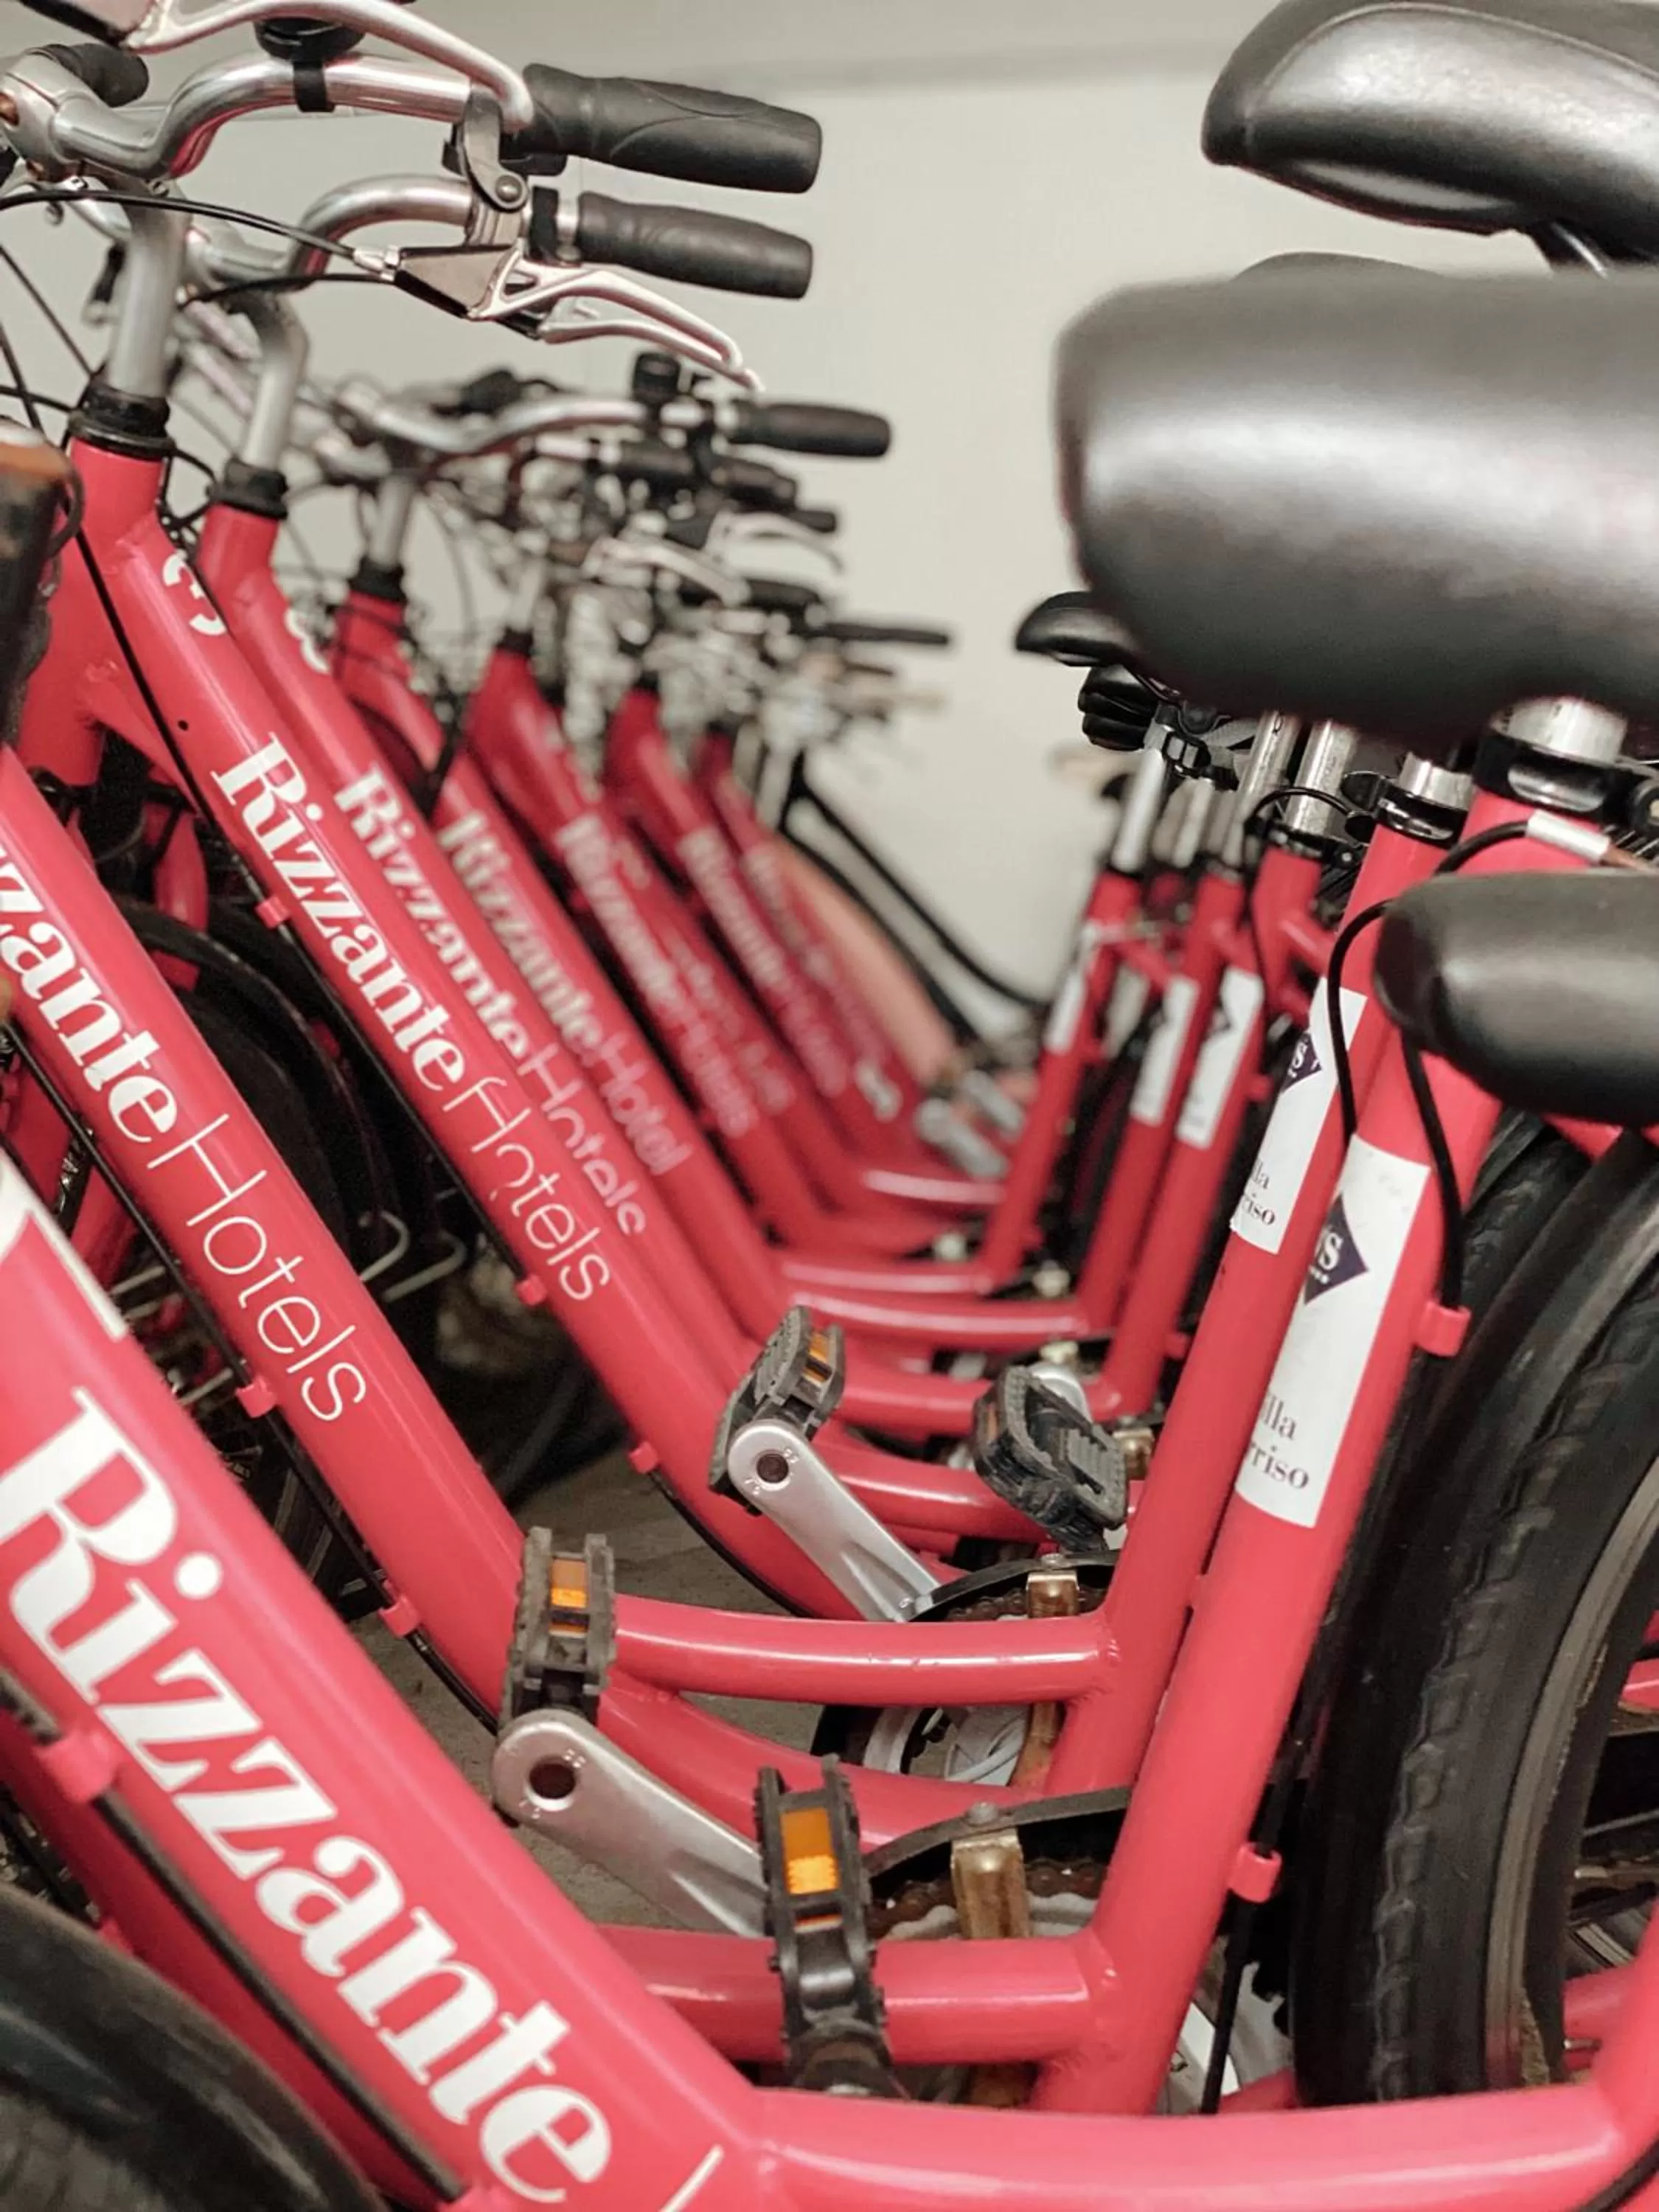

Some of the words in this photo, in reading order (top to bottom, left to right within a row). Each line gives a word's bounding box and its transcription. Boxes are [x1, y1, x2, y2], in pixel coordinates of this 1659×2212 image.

[211, 731, 465, 1091] Rizzante
[148, 1113, 366, 1421] Hotels
[1263, 1394, 1296, 1440] lla
[0, 1386, 612, 2203] Rizzante
